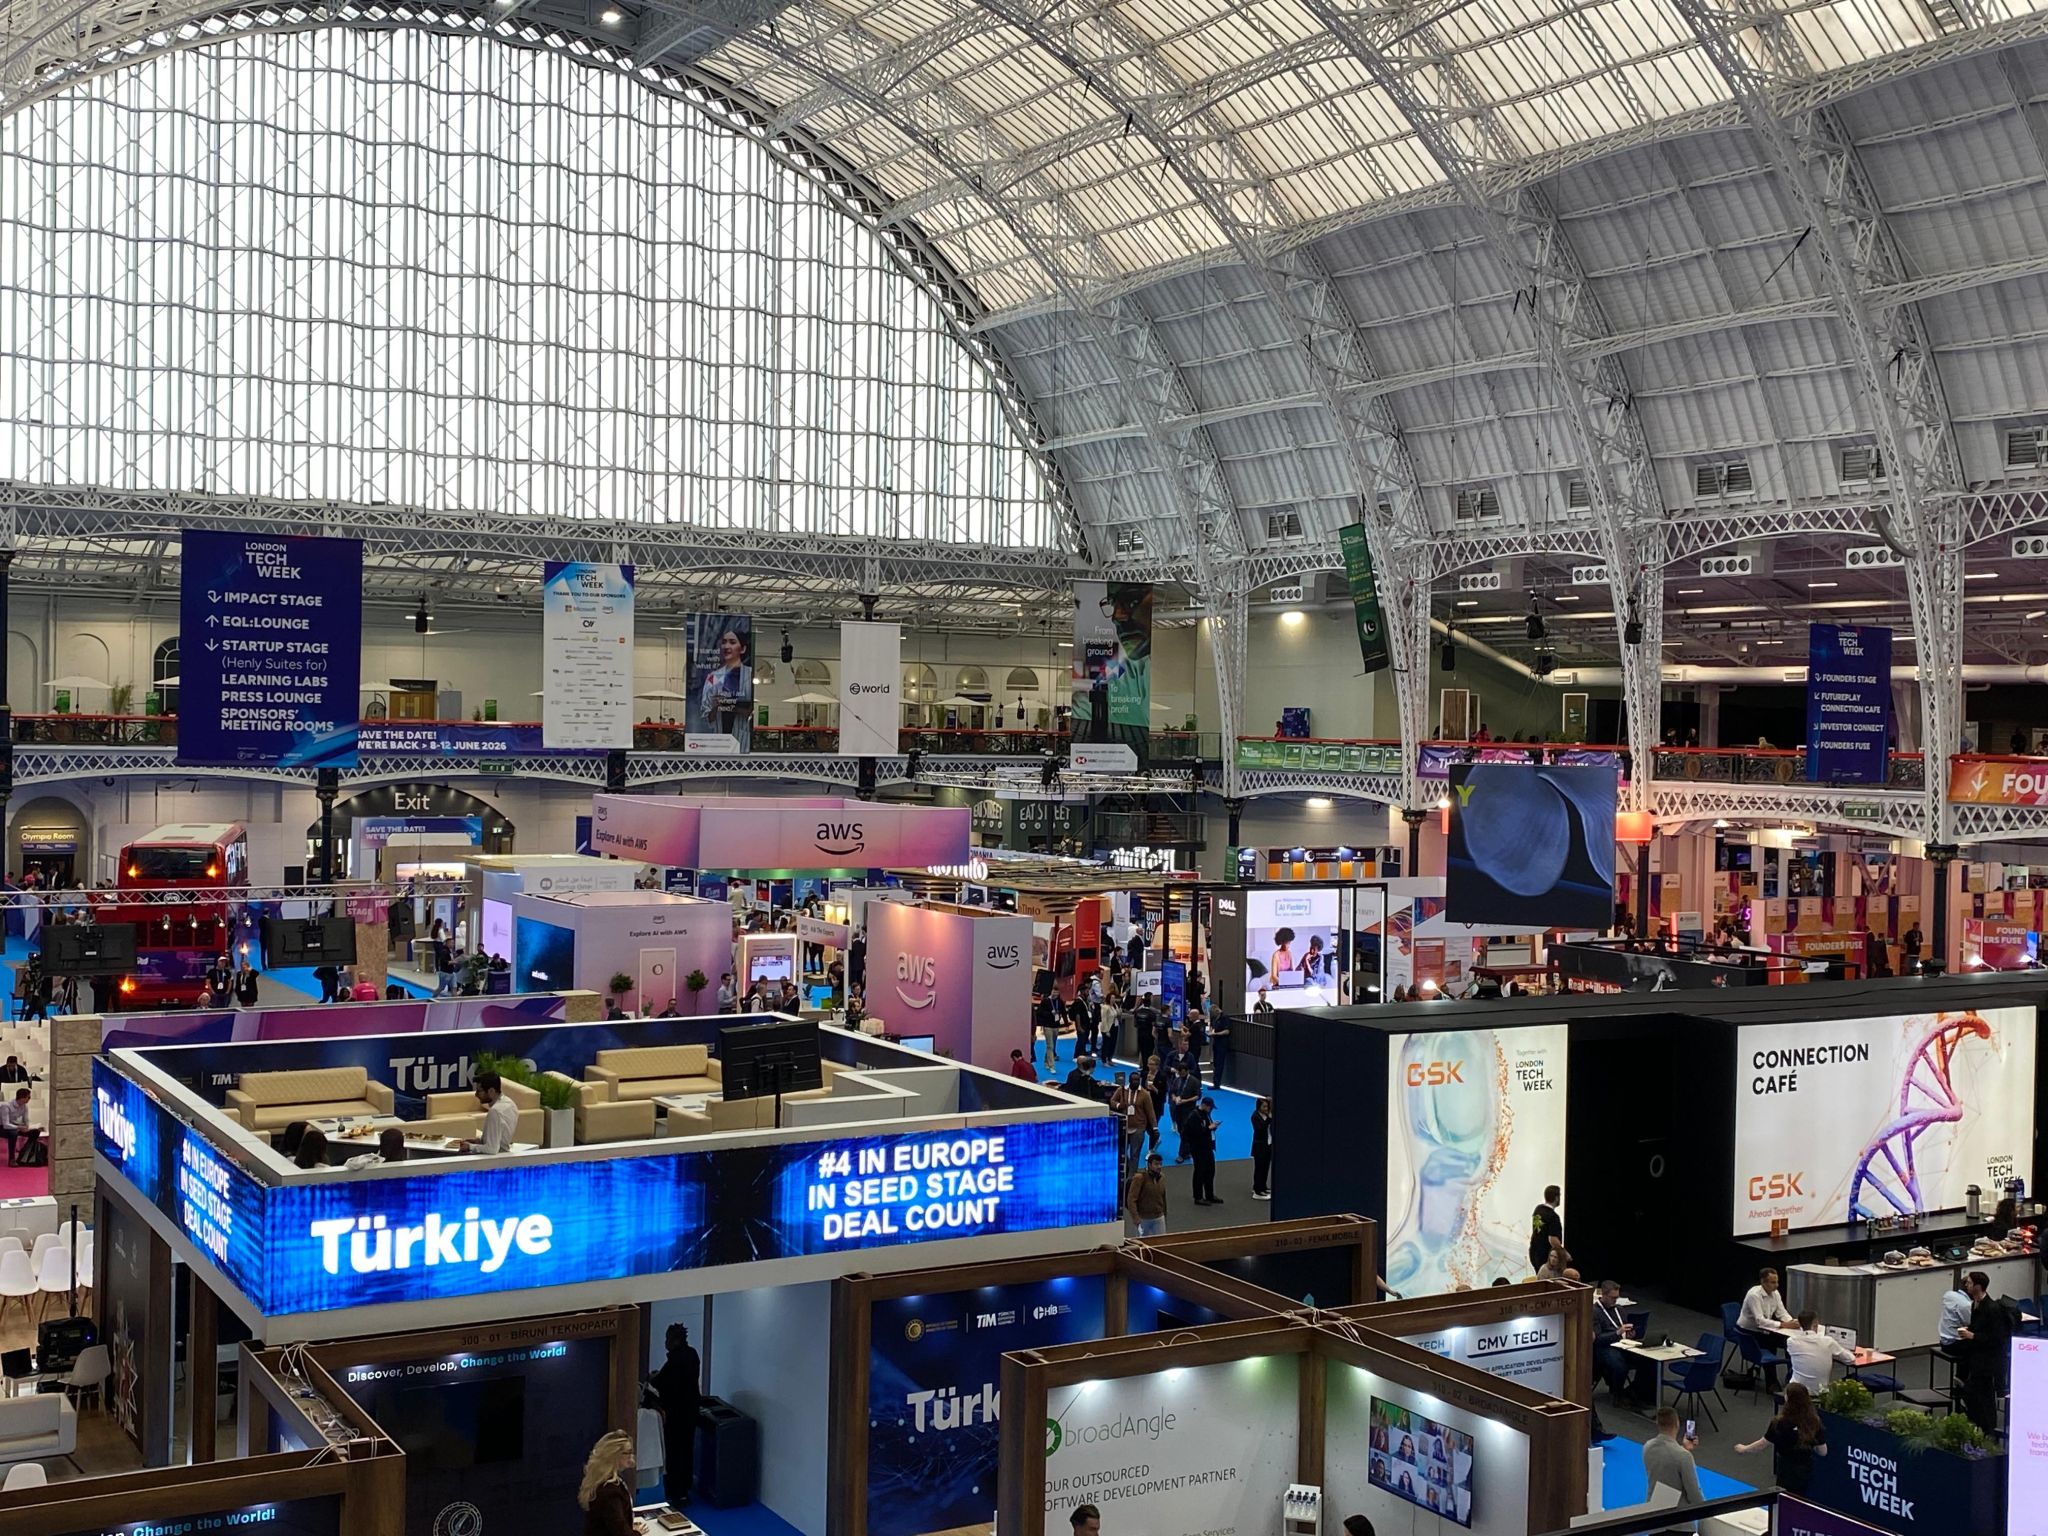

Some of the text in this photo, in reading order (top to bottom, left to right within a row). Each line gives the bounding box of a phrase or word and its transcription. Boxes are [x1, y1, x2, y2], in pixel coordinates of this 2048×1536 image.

[245, 542, 287, 552] LONDON
[245, 552, 287, 565] TECH
[257, 566, 301, 579] WEEK
[224, 592, 322, 607] IMPACT STAGE
[222, 616, 310, 629] EQL:LOUNGE
[1095, 626, 1114, 635] From
[222, 640, 329, 654] STARTUP STAGE
[1083, 637, 1113, 648] breaking
[1838, 638, 1858, 646] TECH
[1087, 648, 1113, 656] ground
[1843, 647, 1864, 656] WEEK
[222, 655, 327, 672] (Henly Suites for)
[222, 674, 328, 687] LEARNING LABS
[1822, 673, 1877, 684] FOUNDERS STAGE
[861, 684, 890, 693] world
[221, 691, 321, 704] PRESS LOUNGE
[1111, 695, 1142, 705] breaking
[1821, 693, 1861, 701] FUTUREPLAY
[1111, 705, 1129, 715] profit
[1821, 705, 1881, 714] CONNECTION CAFE
[221, 720, 334, 732] MEETING ROOMS
[1820, 723, 1884, 732] INVESTOR CONNECT
[384, 731, 404, 740] THE
[407, 731, 437, 740] DATE!
[390, 741, 419, 750] BACK
[430, 741, 451, 750] 8-12
[453, 741, 480, 750] JUNE
[482, 742, 506, 750] 2026
[1820, 742, 1871, 750] FOUNDERS FUSE
[394, 793, 430, 811] Exit
[1020, 803, 1036, 820] EAT
[21, 832, 74, 842] Olympia Room
[596, 829, 648, 850] Explore AI with AWS
[1218, 899, 1236, 911] DELL
[1287, 904, 1308, 912] Factory
[347, 908, 373, 916] STAGE
[1805, 941, 1845, 951] FOUNDERS
[1845, 940, 1863, 949] FUSE
[1984, 936, 2022, 944] ERS FUSE
[1568, 978, 1584, 992] Real
[1753, 1044, 1869, 1070] CONNECTION
[1516, 1060, 1544, 1068] LONDON
[1407, 1060, 1465, 1087] GSK
[1516, 1068, 1544, 1080] TECH
[1523, 1079, 1553, 1091] WEEK
[1752, 1070, 1798, 1095] CAFÉ
[97, 1087, 136, 1161] Türkiye
[818, 1137, 1005, 1179] #4 IN EUROPE
[1987, 1155, 2013, 1164] LONDON
[191, 1144, 199, 1174] IN
[199, 1152, 231, 1200] EUROPE
[1987, 1164, 2013, 1177] TECH
[808, 1166, 1014, 1211] IN SEED STAGE
[1749, 1172, 1804, 1201] GSK
[180, 1166, 232, 1235] IN SEED STAGE
[1749, 1204, 1804, 1219] Ahead Together
[823, 1197, 1000, 1241] DEAL COUNT
[184, 1199, 229, 1264] DEAL COUNT
[310, 1207, 553, 1275] Türkiye
[1535, 1301, 1552, 1312] CMV
[1556, 1297, 1577, 1308] TECH
[461, 1335, 479, 1346] 300
[490, 1334, 500, 1343] 01
[551, 1318, 616, 1336] TEKNOPARK
[1477, 1329, 1548, 1351] CMV TECH
[348, 1347, 567, 1383] Discover, Develop, Change the World!
[1491, 1355, 1563, 1372] APPLICATION DEVELOPMENT
[1514, 1366, 1542, 1375] SOLUTIONS
[1065, 1406, 1176, 1447] broadAngle
[1848, 1445, 1897, 1473] LONDON
[1072, 1464, 1150, 1490] OUTSOURCED
[1848, 1460, 1897, 1494] TECH
[1103, 1475, 1186, 1501] DEVELOPMENT
[1189, 1467, 1236, 1488] PARTNER
[1860, 1484, 1915, 1521] WEEK
[133, 1522, 192, 1536] Change
[197, 1517, 221, 1530] the
[226, 1508, 276, 1524] World!
[1203, 1527, 1236, 1536] Services
